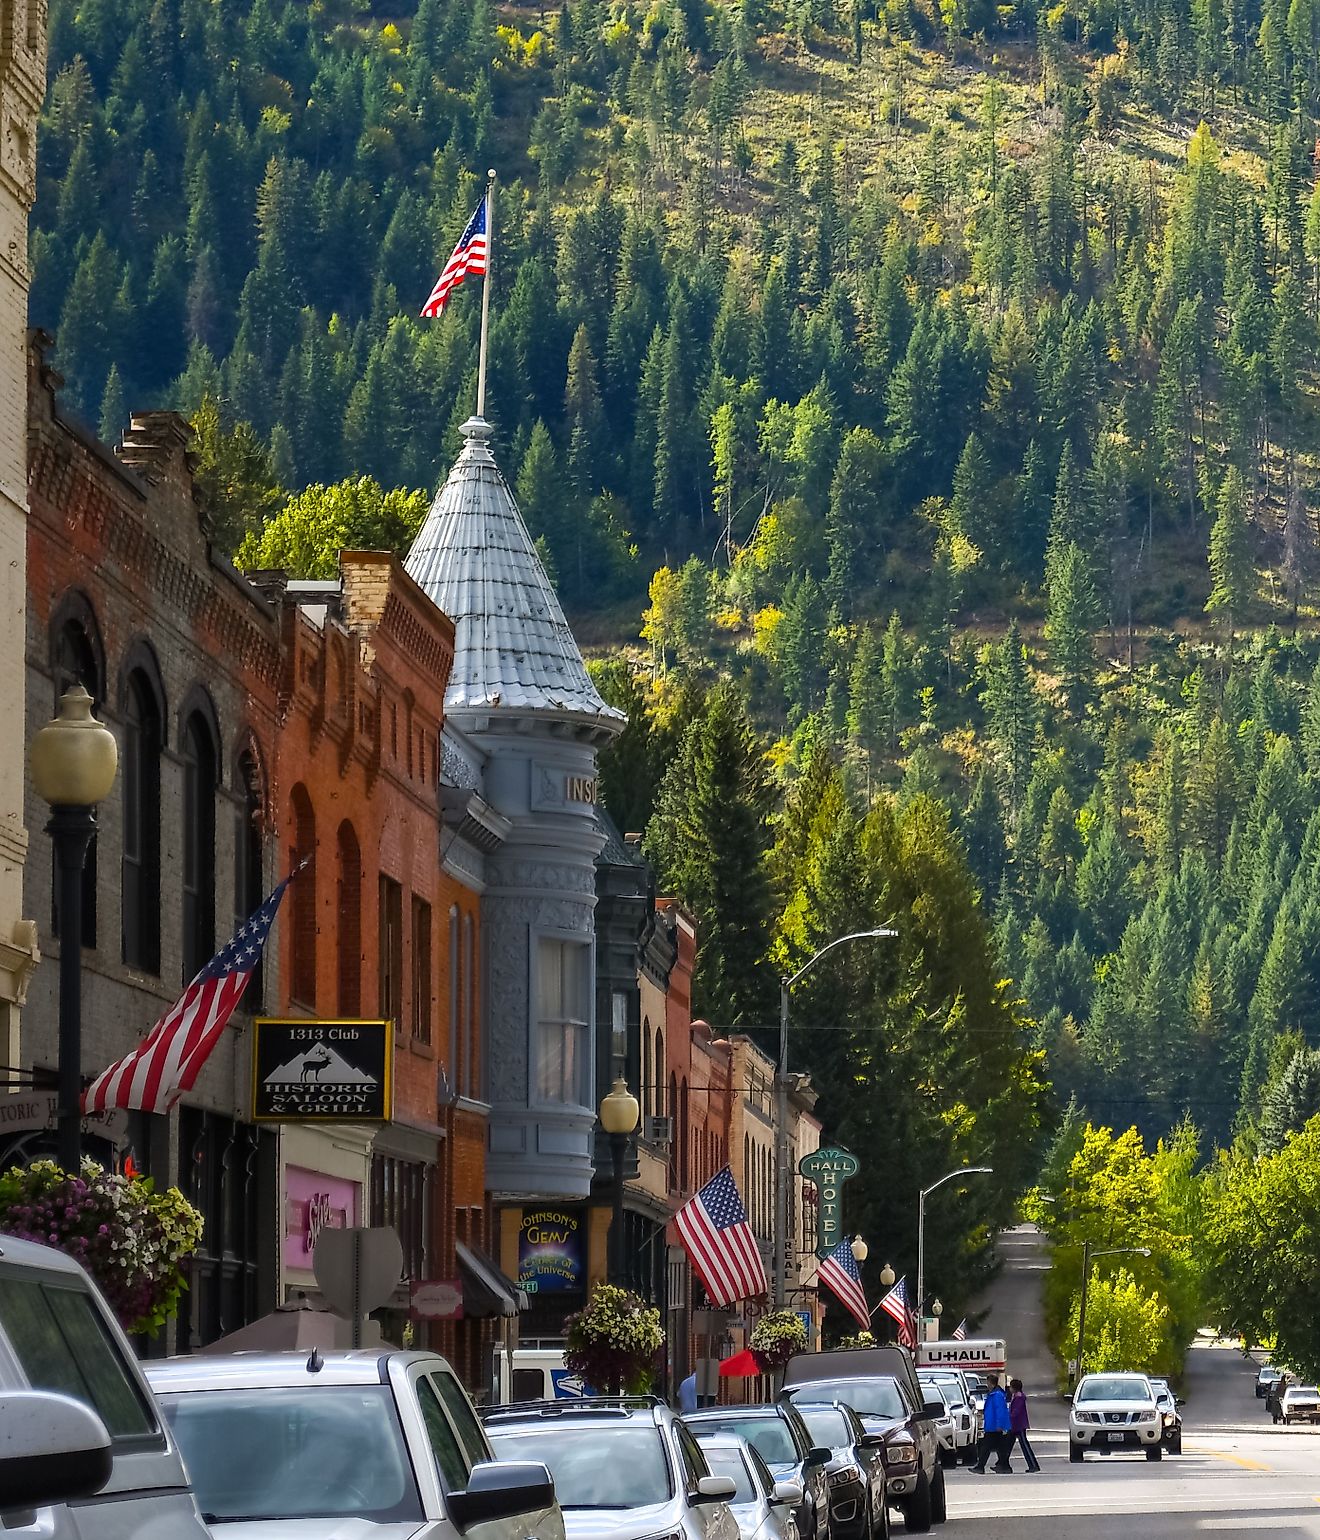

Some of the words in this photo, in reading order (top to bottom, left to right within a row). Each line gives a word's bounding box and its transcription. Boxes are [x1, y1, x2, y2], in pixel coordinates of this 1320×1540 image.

[289, 1029, 323, 1040] 1313
[328, 1029, 359, 1040] Club
[264, 1085, 377, 1093] HISTORIC
[272, 1094, 368, 1103] SALOON
[268, 1104, 286, 1113] &
[297, 1104, 371, 1113] GRILL
[810, 1162, 851, 1171] HALL
[822, 1172, 837, 1247] HOTEL
[520, 1212, 578, 1231] JOHNSON'S
[784, 1241, 793, 1279] REAL
[520, 1269, 536, 1282] the
[537, 1266, 577, 1282] Universe
